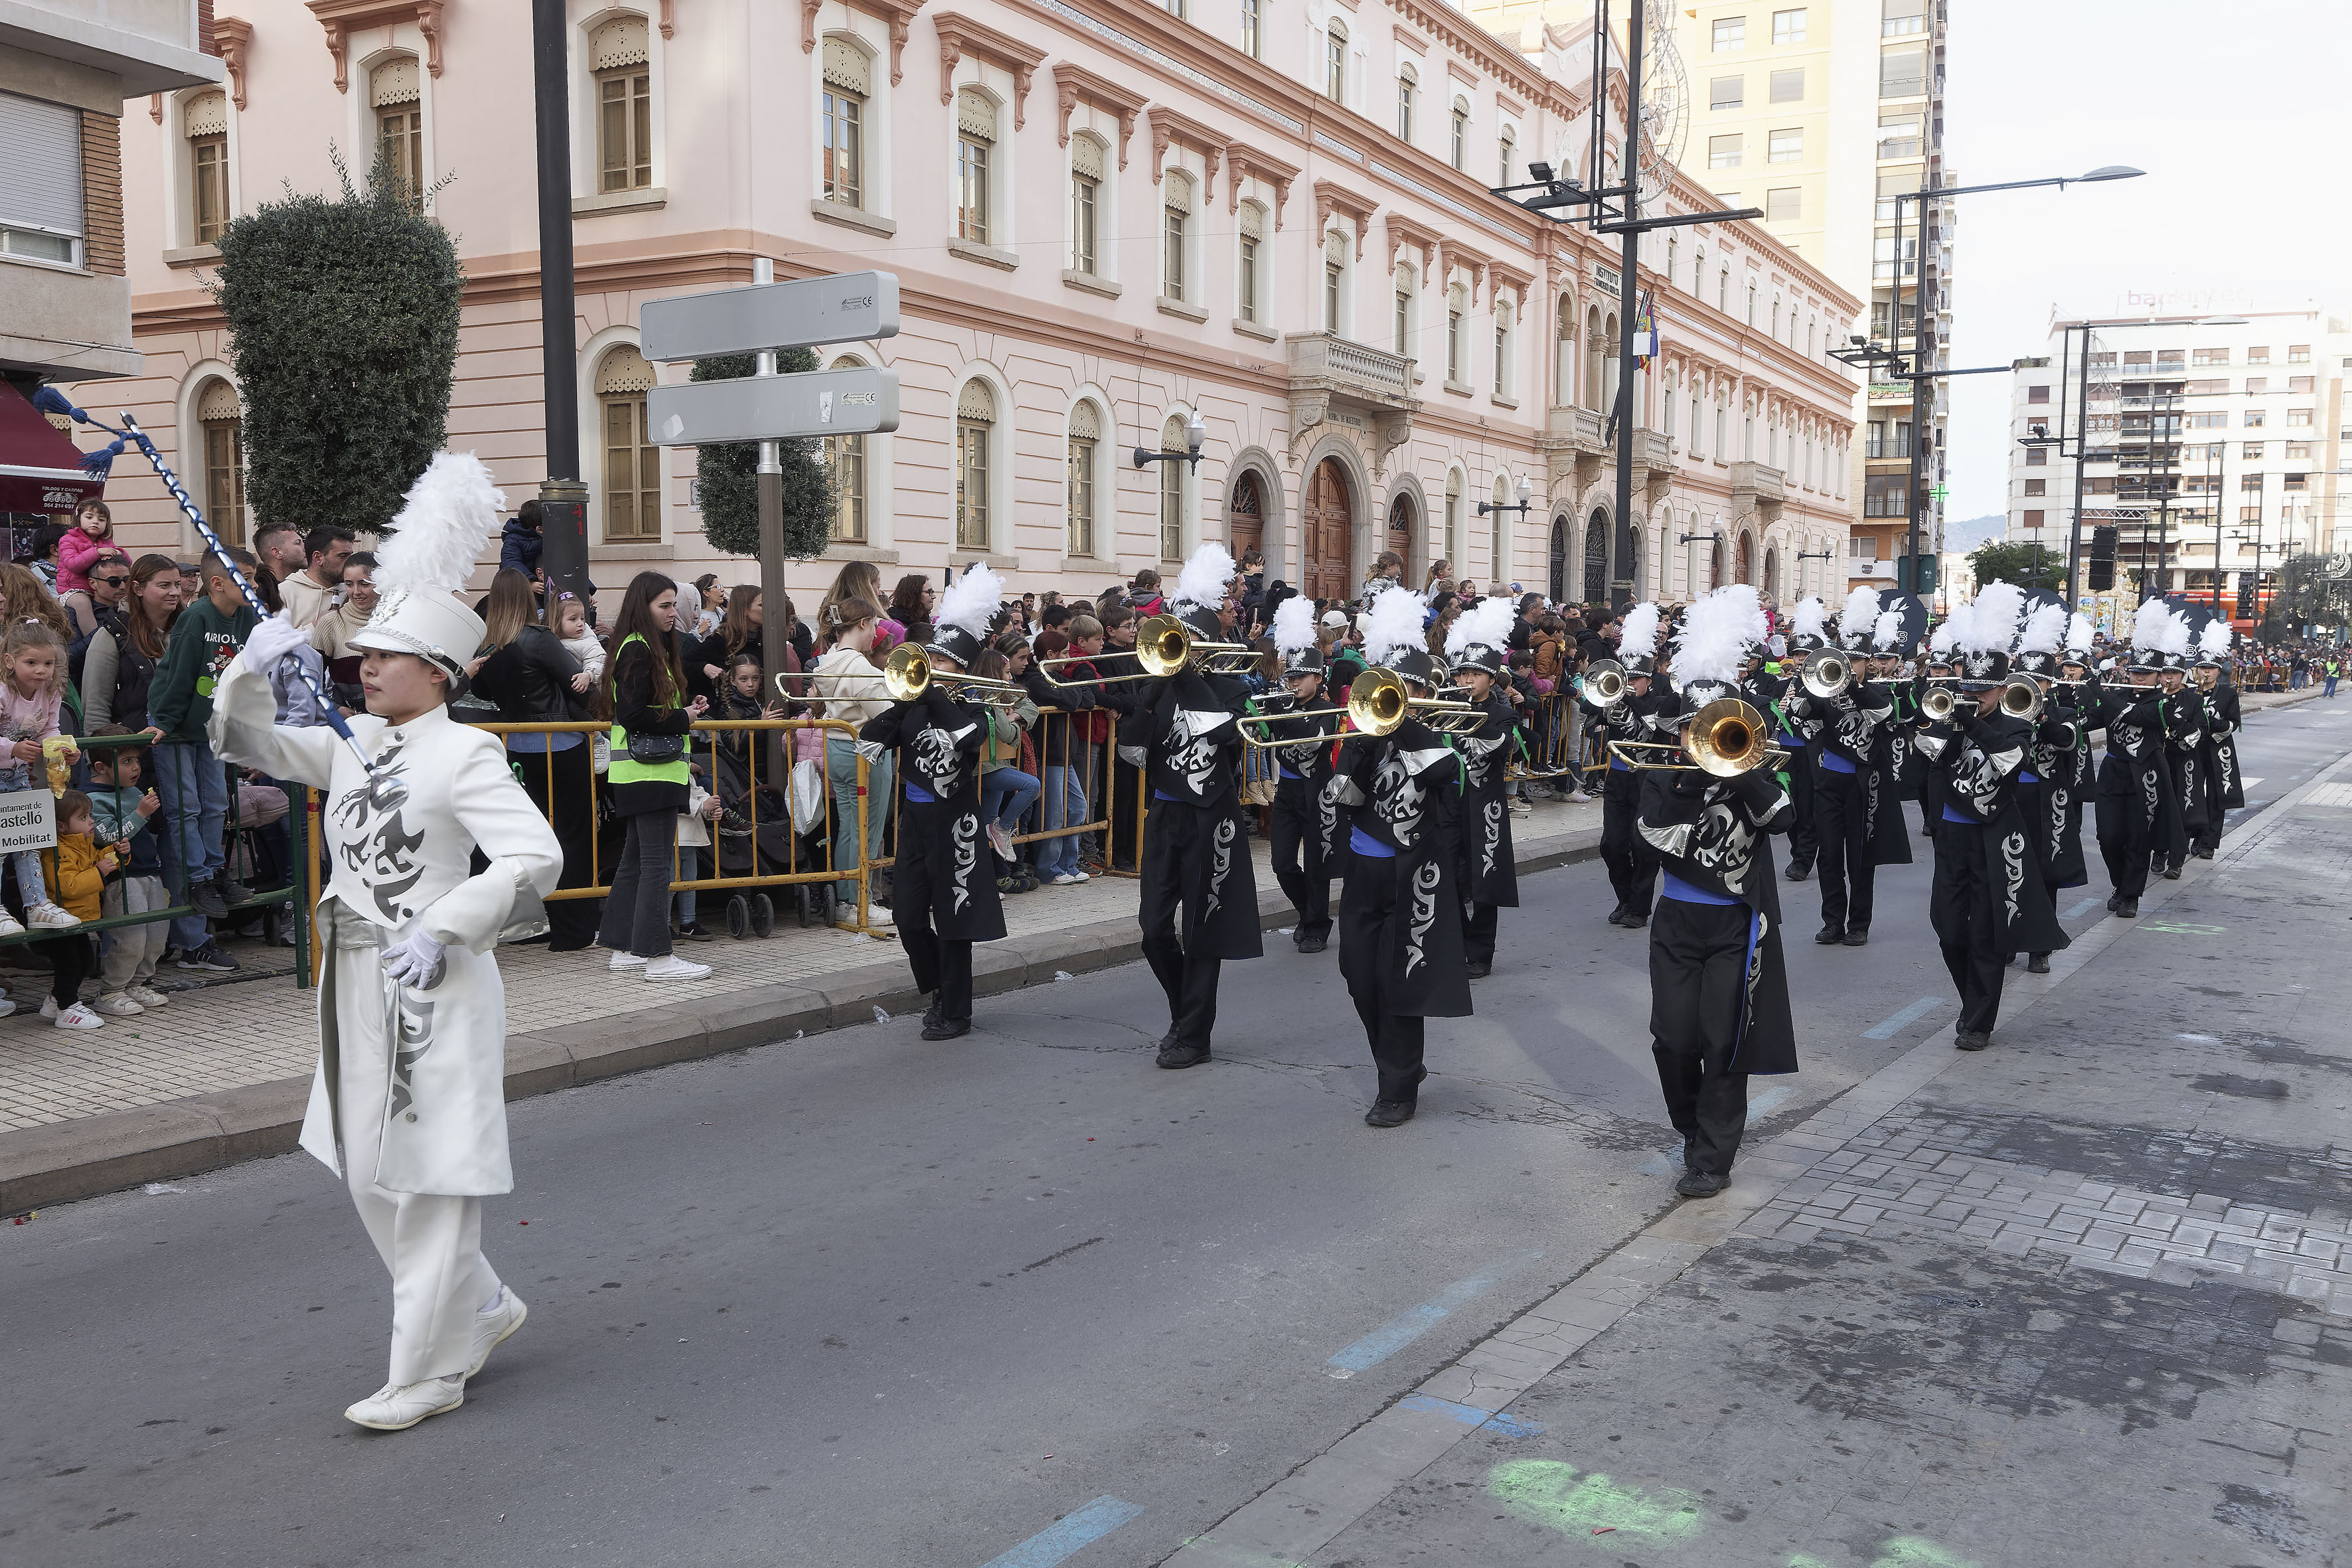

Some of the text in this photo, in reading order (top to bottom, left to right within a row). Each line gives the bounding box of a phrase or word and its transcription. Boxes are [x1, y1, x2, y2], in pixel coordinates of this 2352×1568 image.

[1596, 264, 1618, 285] INSTITUTO
[204, 632, 238, 644] MARIO &
[0, 811, 42, 828] astelló
[2, 833, 51, 847] Mobilitat
